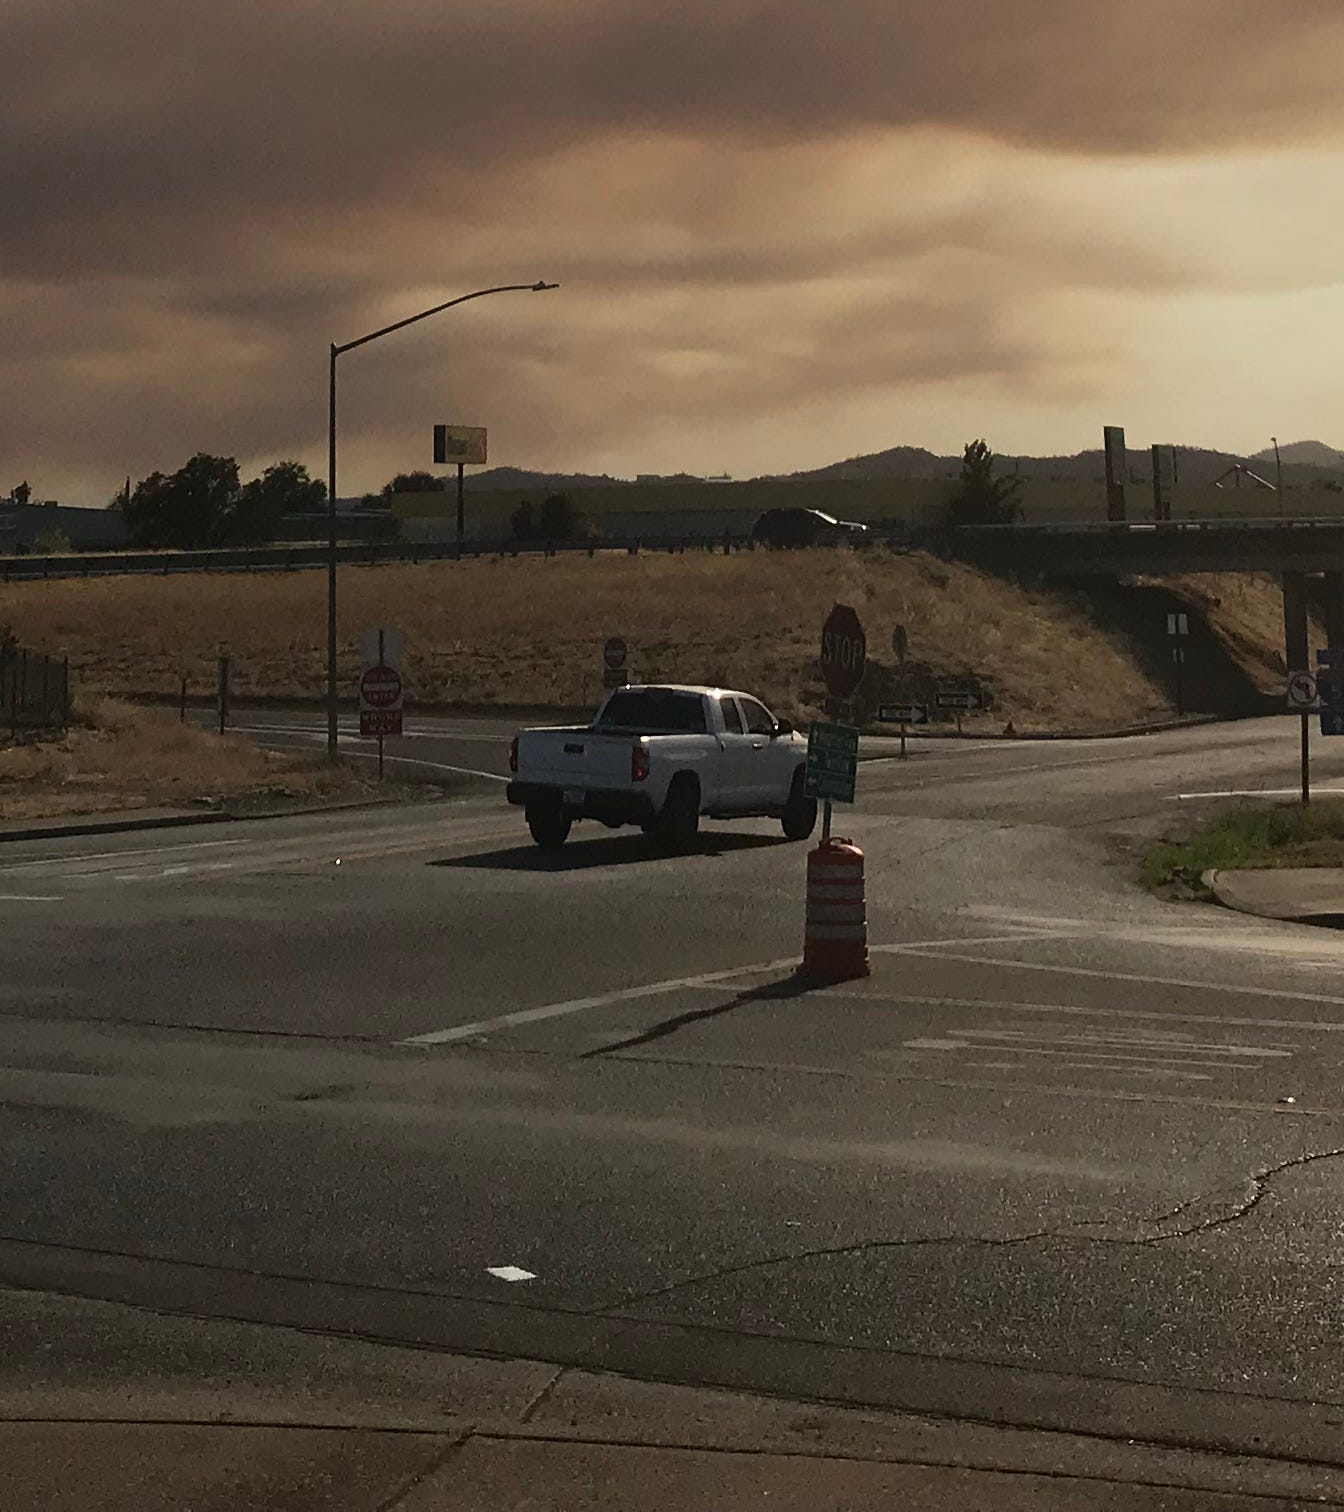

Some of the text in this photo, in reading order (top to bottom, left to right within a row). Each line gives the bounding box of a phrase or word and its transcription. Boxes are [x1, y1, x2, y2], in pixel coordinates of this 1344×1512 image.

[824, 632, 864, 670] STOP
[367, 692, 395, 701] ENTER
[362, 712, 400, 721] WRONG
[369, 722, 392, 731] WAY
